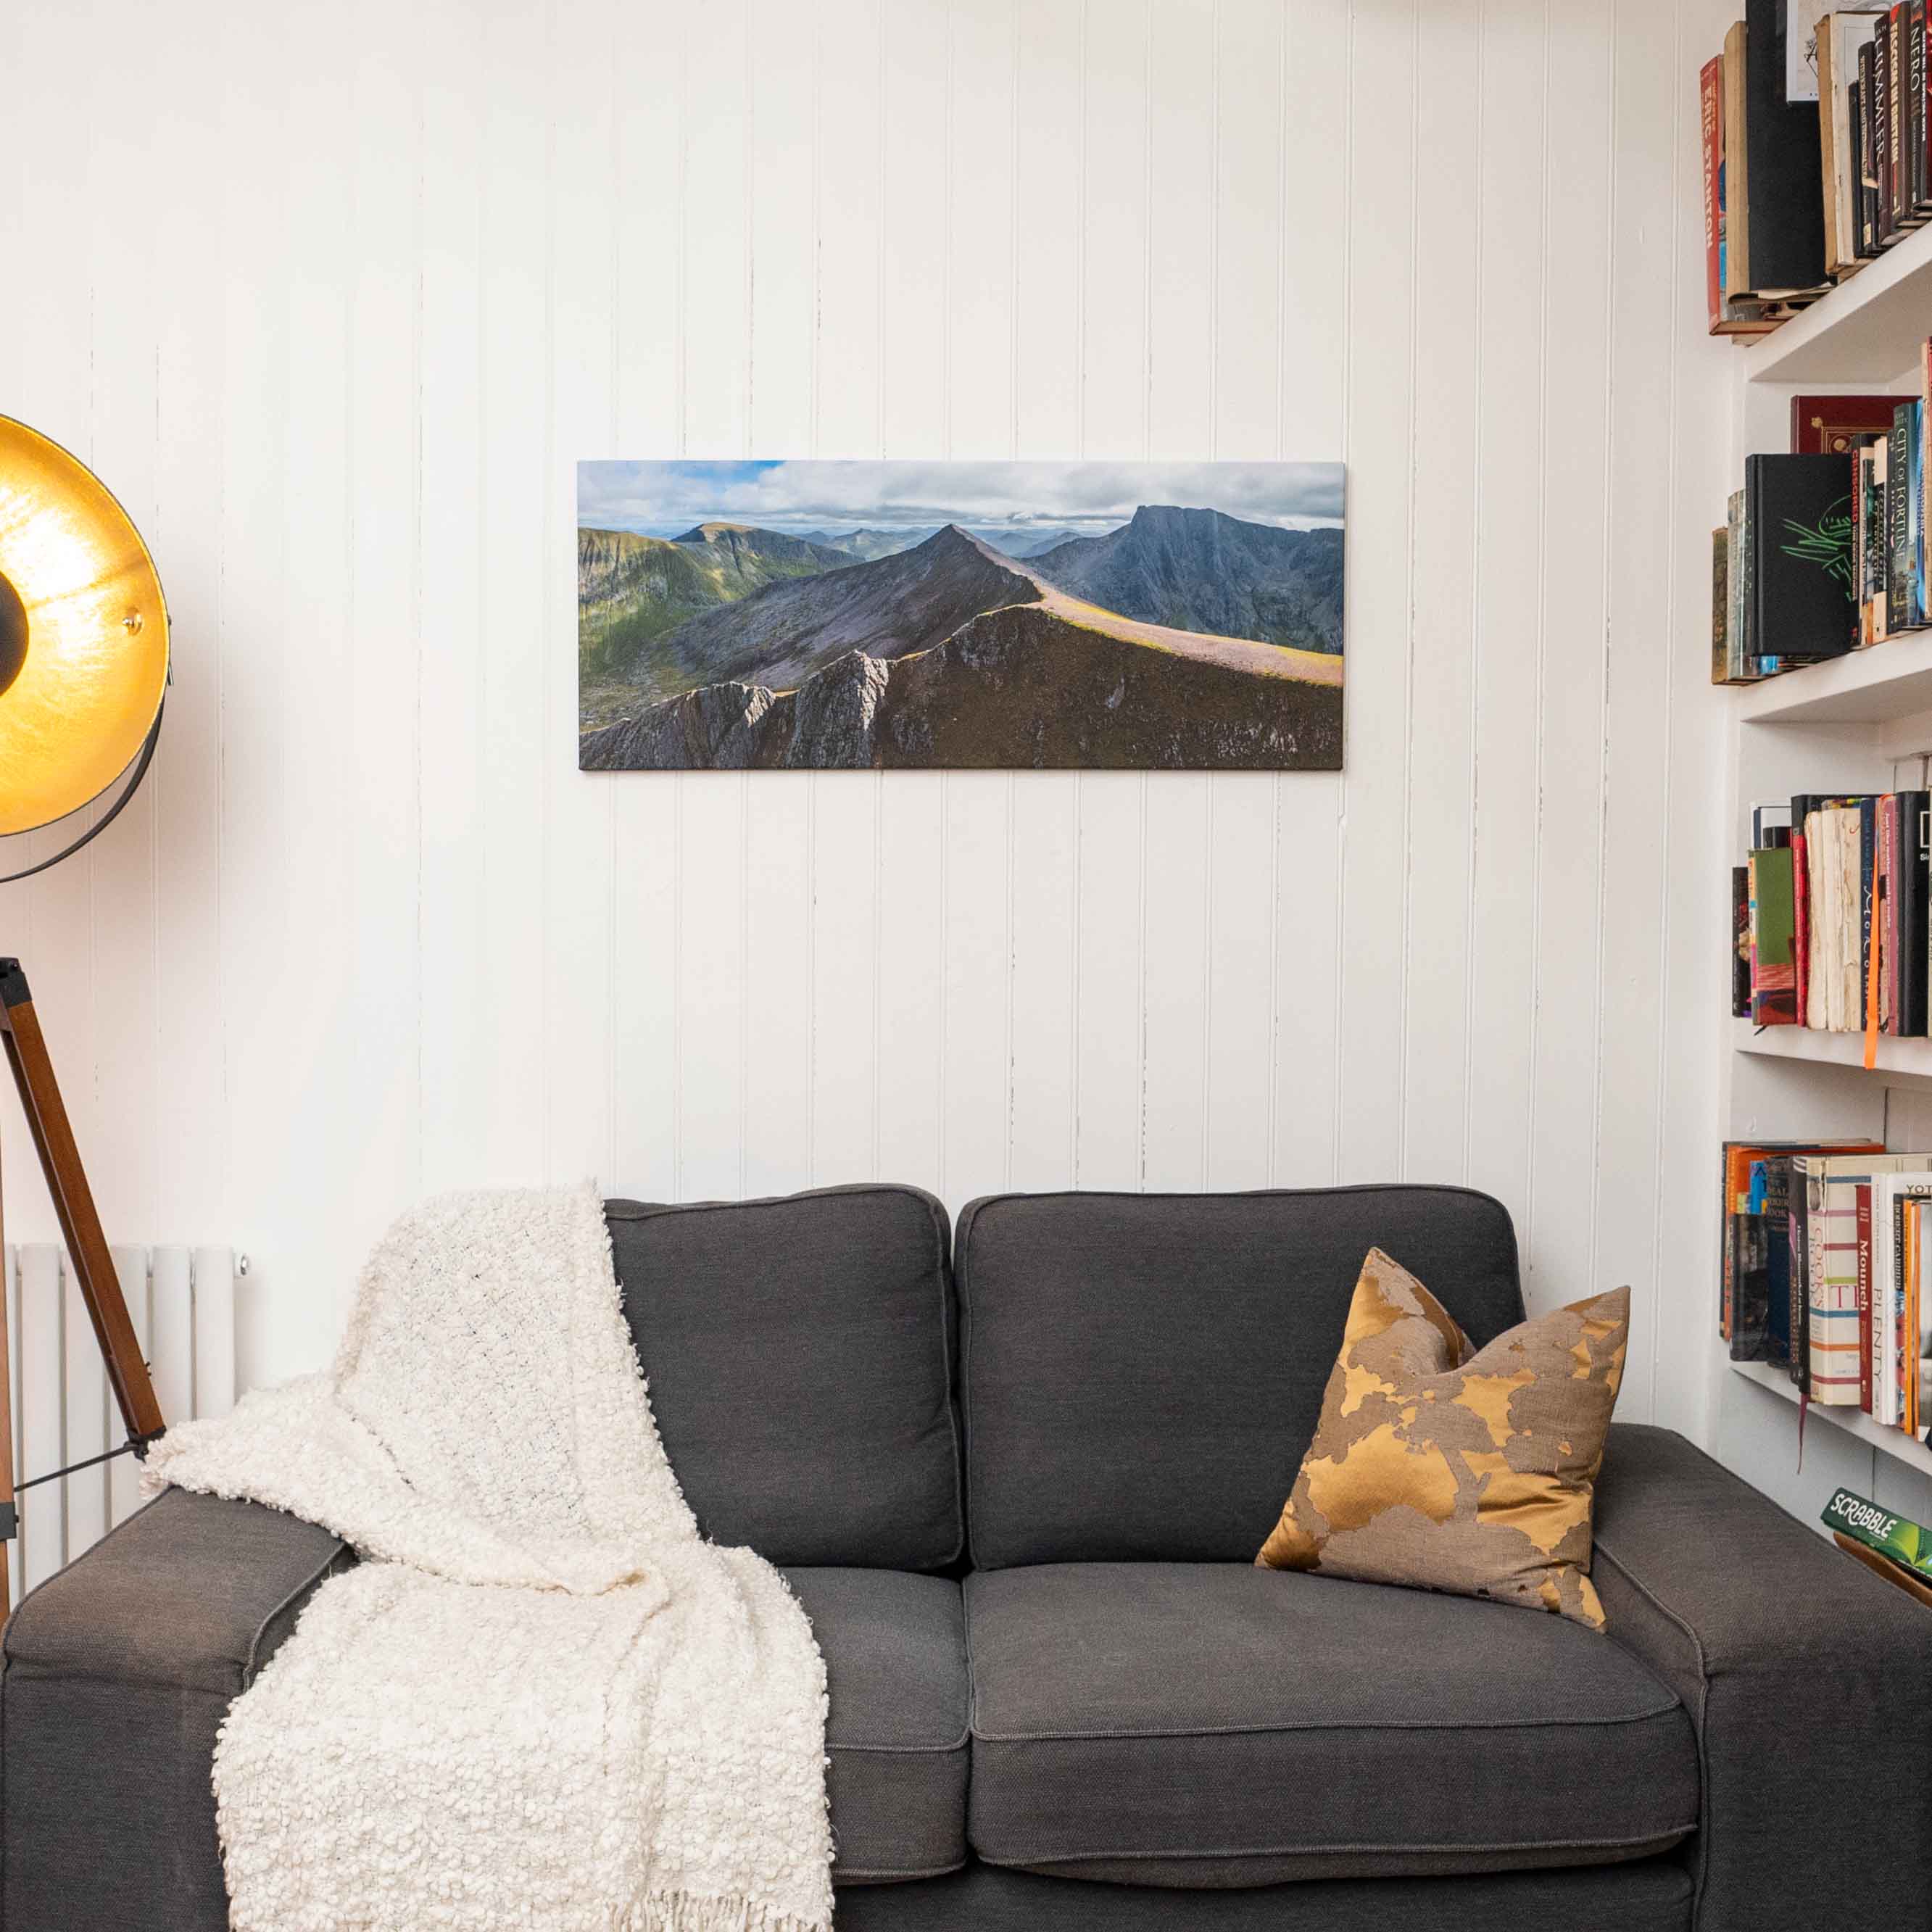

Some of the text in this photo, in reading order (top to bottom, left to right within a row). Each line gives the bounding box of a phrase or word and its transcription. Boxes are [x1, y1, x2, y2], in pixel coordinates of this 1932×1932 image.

[1910, 26, 1920, 91] NERO
[1874, 37, 1885, 162] HIMMLER
[1890, 104, 1899, 164] BRITAIN
[1704, 86, 1714, 249] ERIC STANTON
[1896, 428, 1907, 464] CITY
[1896, 486, 1907, 561] FORTUNE
[1831, 1493, 1897, 1538] SCRABBLE
